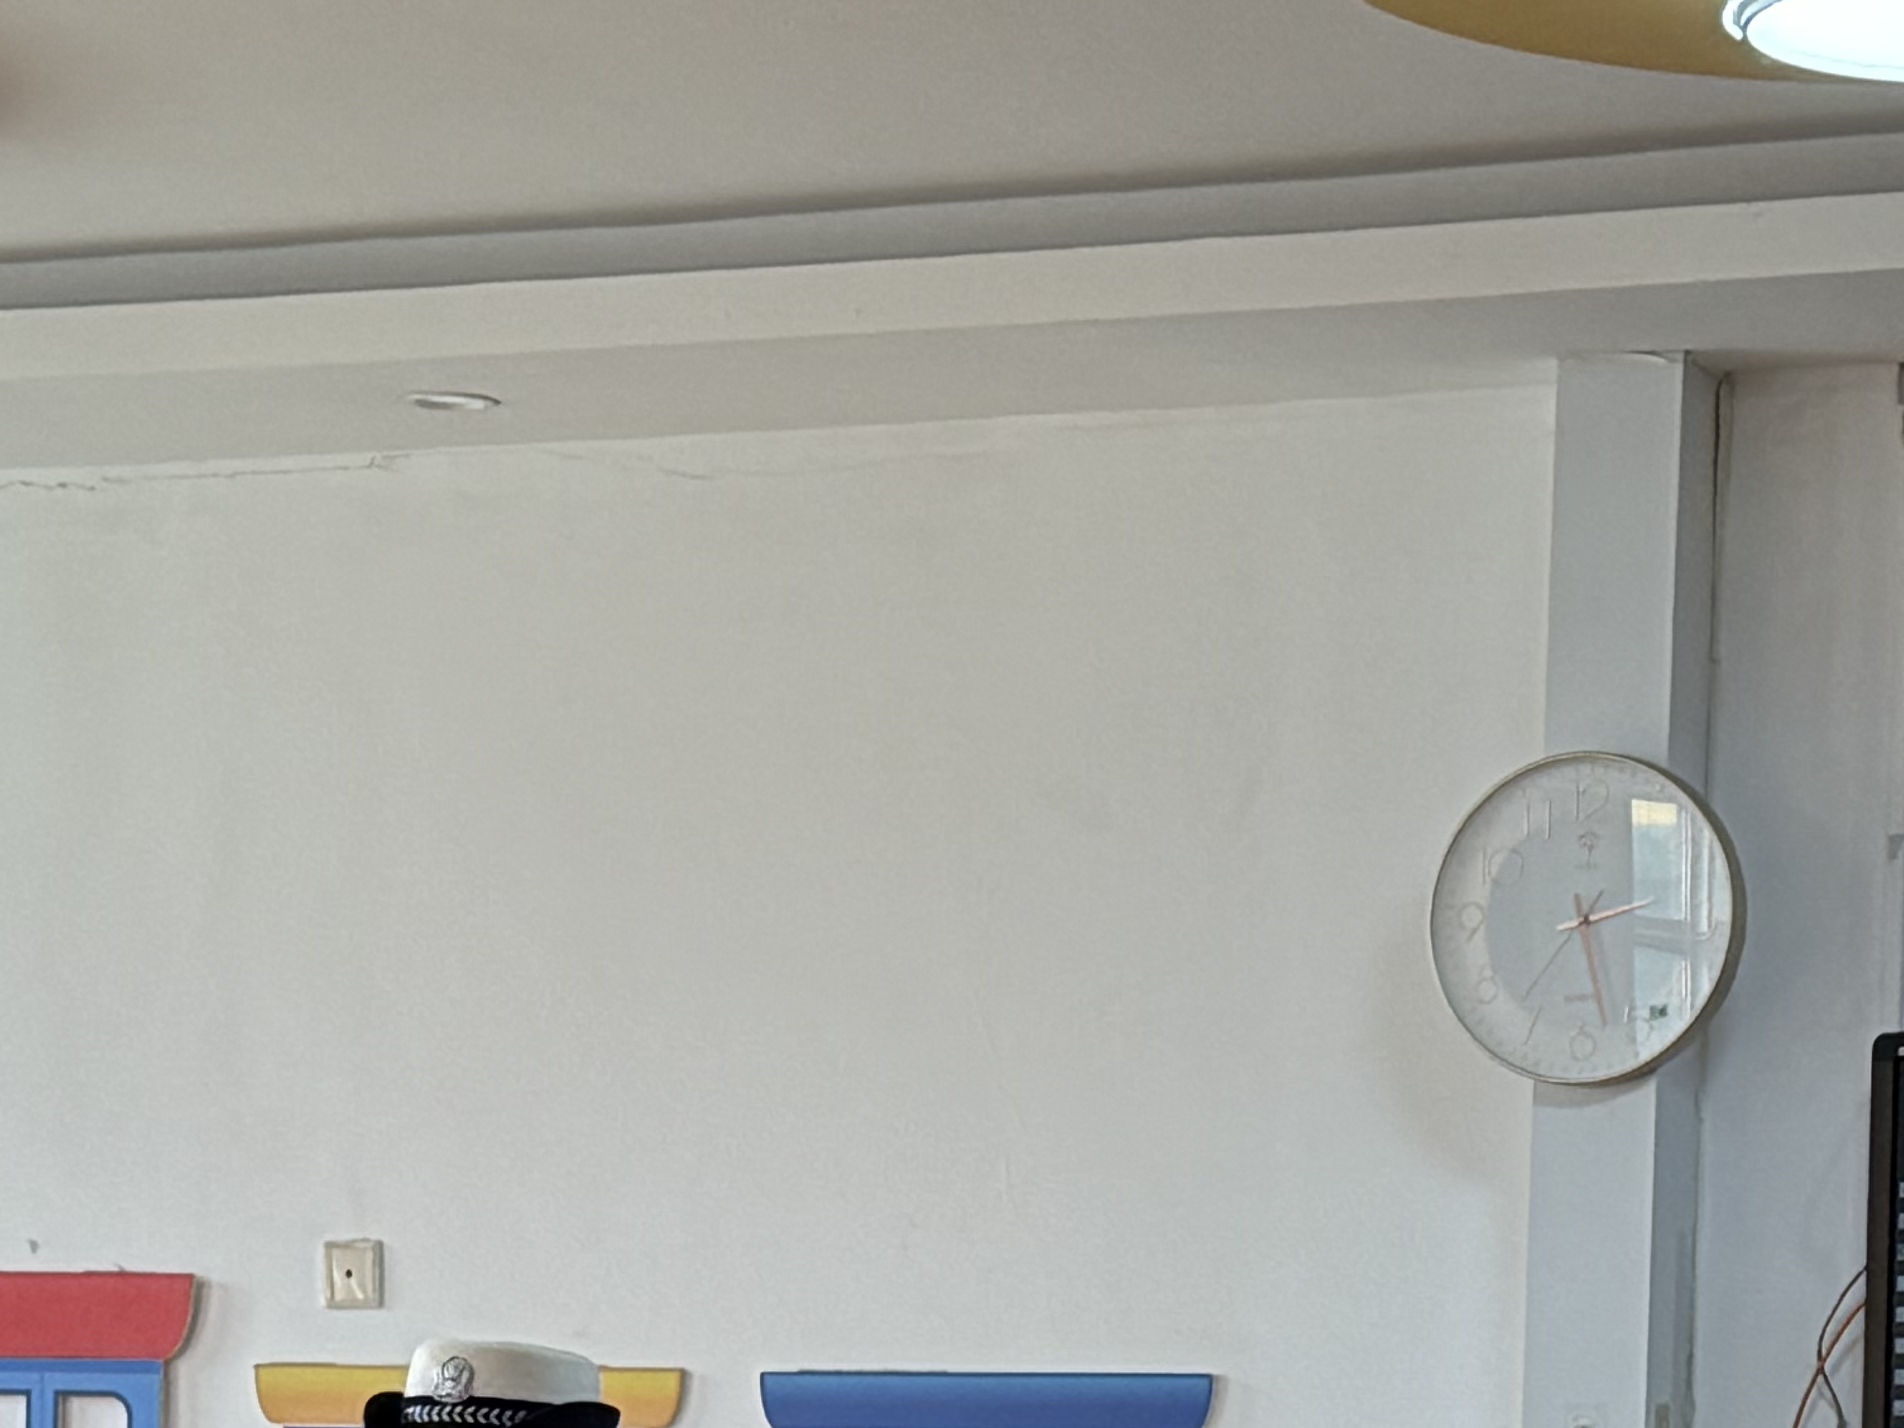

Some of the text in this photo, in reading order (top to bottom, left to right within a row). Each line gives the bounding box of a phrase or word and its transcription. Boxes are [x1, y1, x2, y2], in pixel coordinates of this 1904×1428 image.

[1524, 799, 1552, 841] 11
[1575, 780, 1610, 822] 12
[1481, 846, 1525, 886] 10
[1459, 902, 1484, 942] 9
